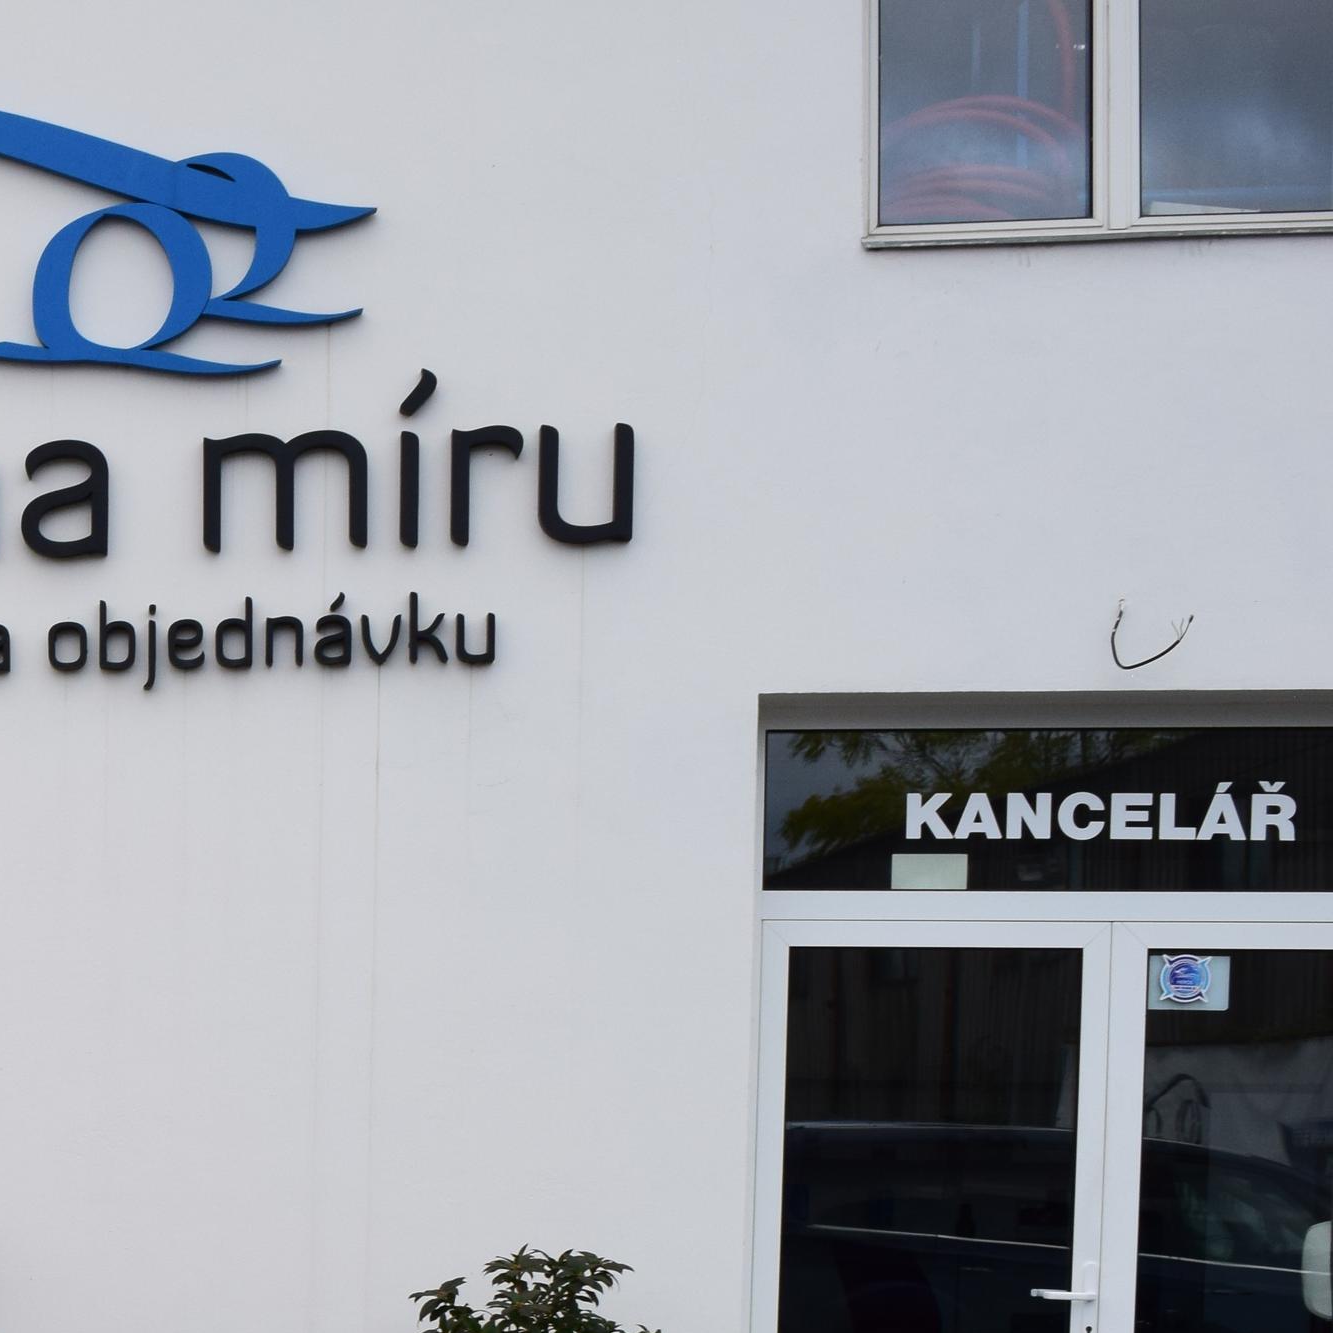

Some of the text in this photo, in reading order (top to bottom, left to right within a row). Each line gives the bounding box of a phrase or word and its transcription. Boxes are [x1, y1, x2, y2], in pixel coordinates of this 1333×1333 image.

[202, 369, 635, 555] míru
[48, 592, 496, 692] objednávku
[905, 781, 1297, 841] KANCELÁŘ
